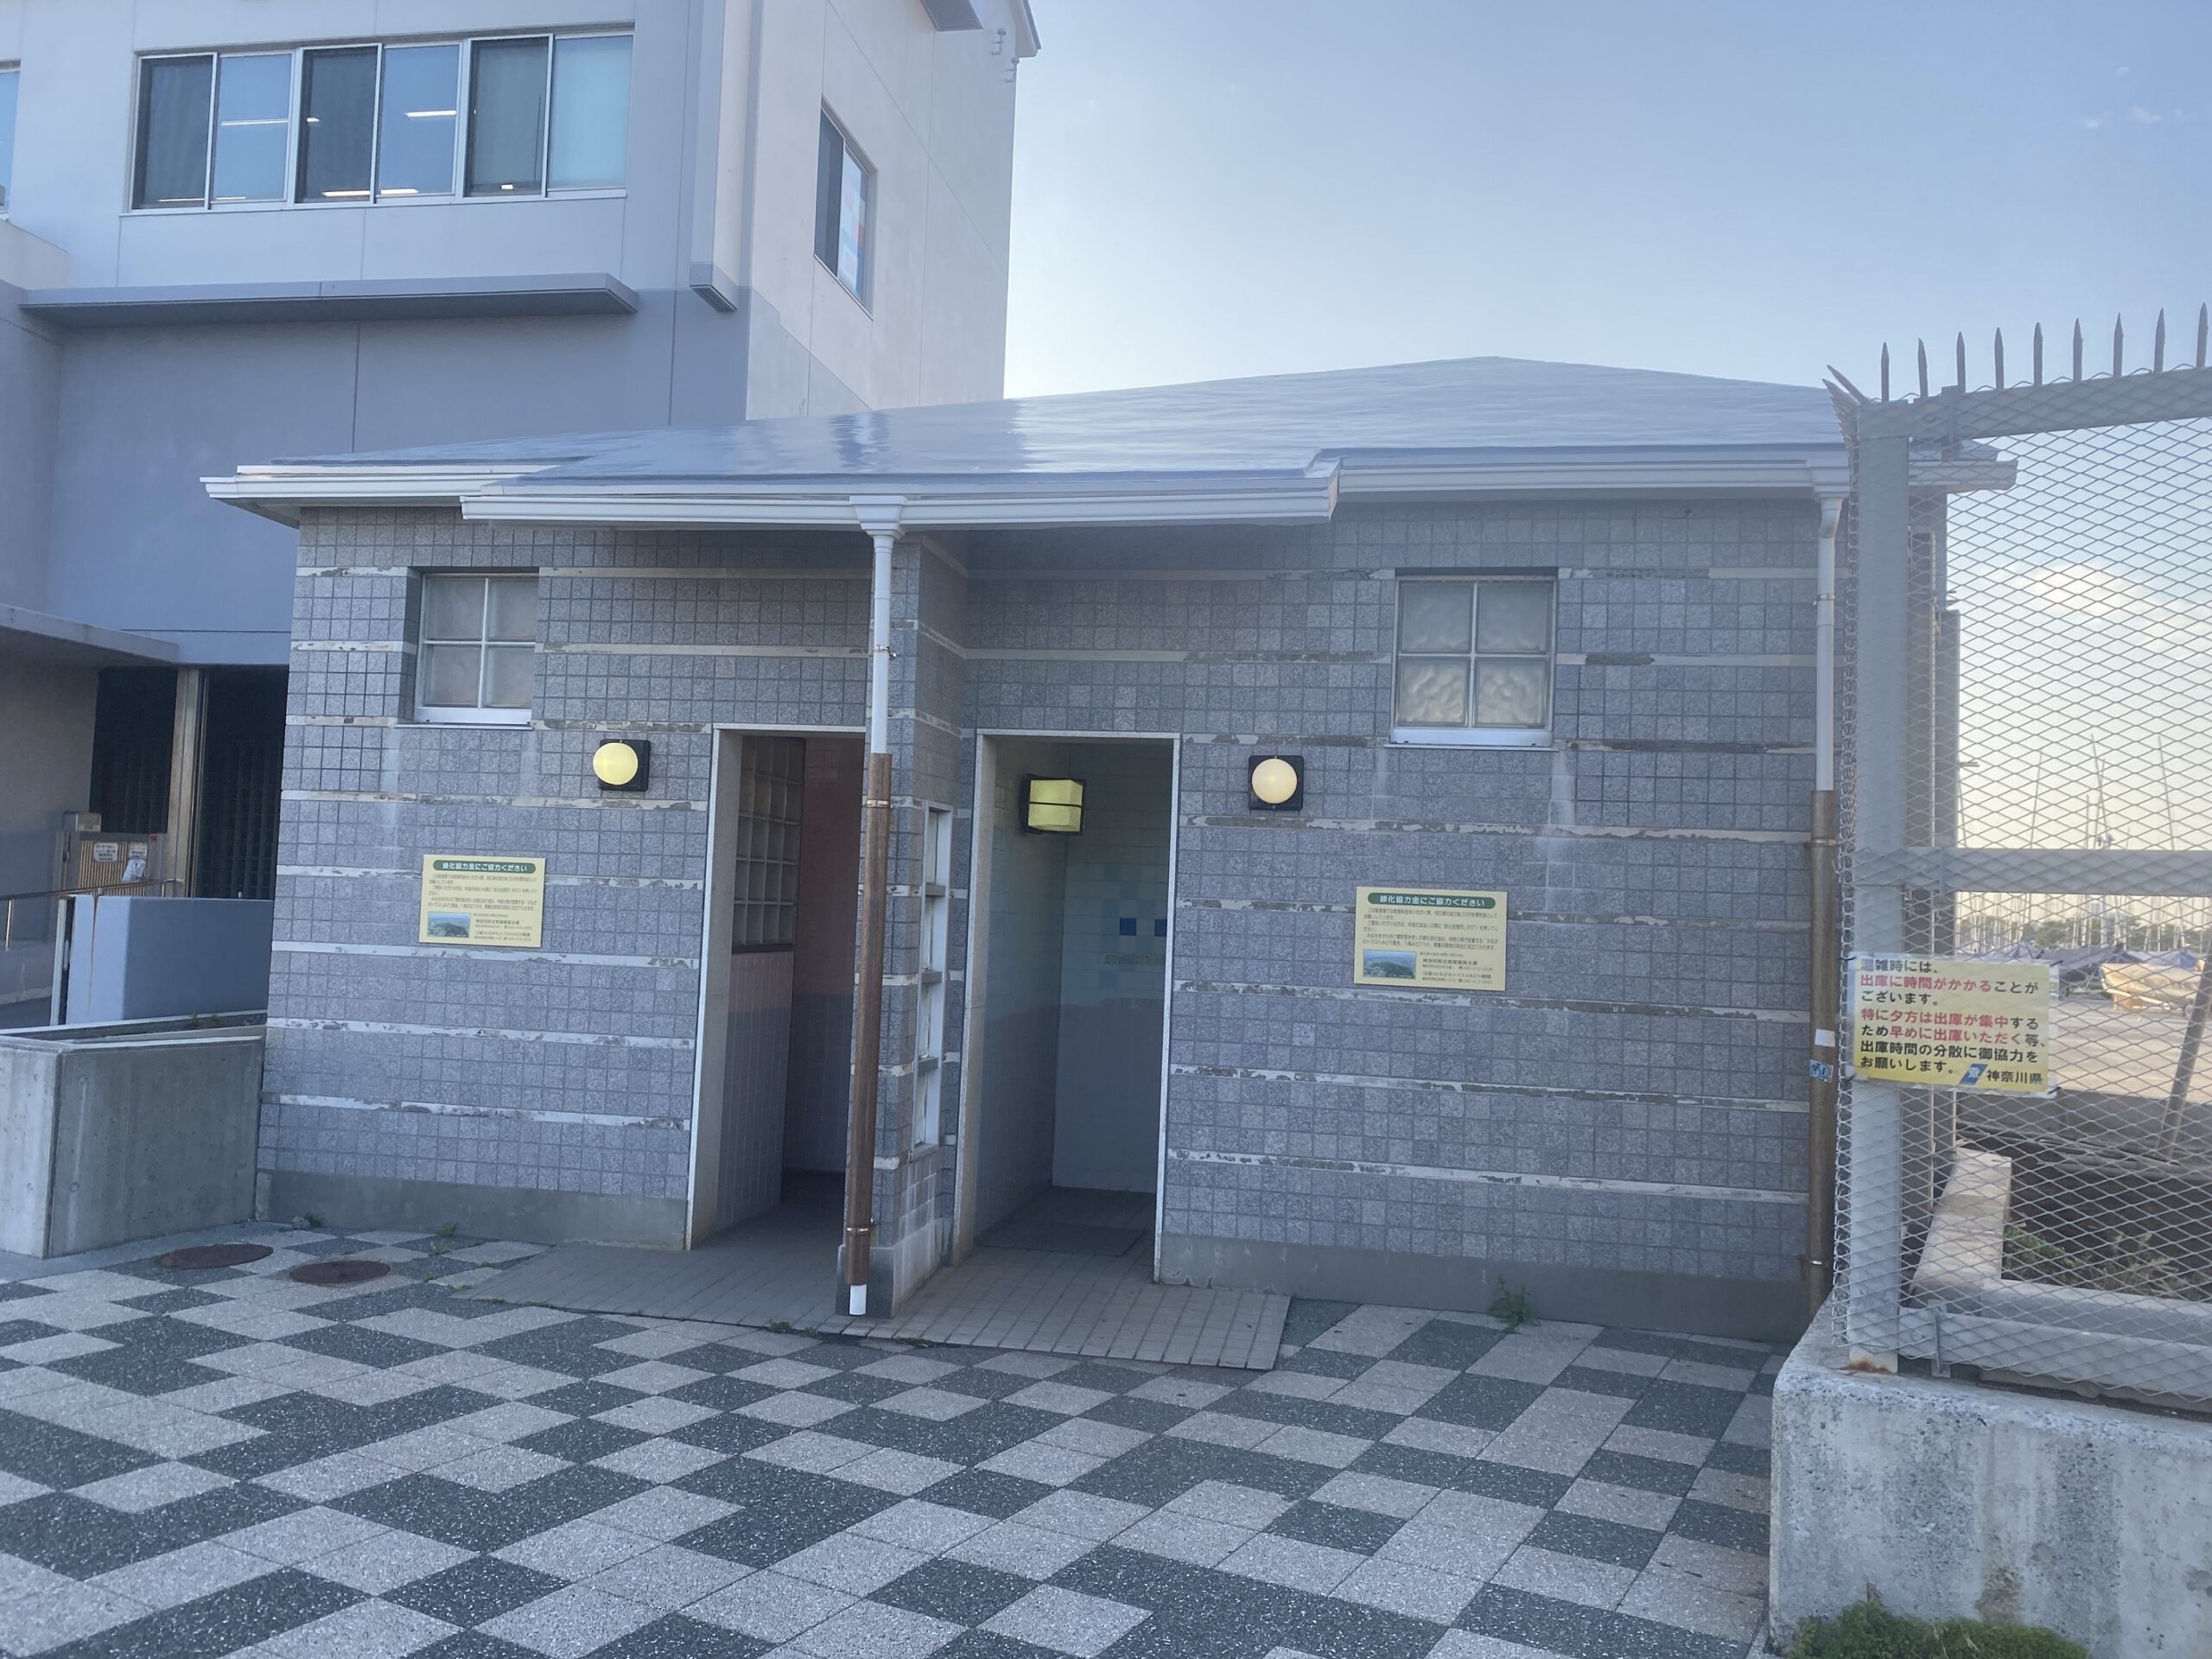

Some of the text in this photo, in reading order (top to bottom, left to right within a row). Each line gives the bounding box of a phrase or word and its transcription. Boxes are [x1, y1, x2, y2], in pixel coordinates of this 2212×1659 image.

[1380, 895, 1484, 906] 緑化協力金にご協力ください
[1860, 974, 2038, 995] 出庫に時間がかかることが
[1861, 990, 1939, 1006] ございます。
[1861, 1008, 2039, 1030] 特に夕方は出庫が集中する
[1861, 1025, 2045, 1048] ため早めに出庫いただく等、
[1860, 1040, 2038, 1063] 出庫時間の分散に御協力を
[1860, 1056, 1955, 1074] お願いします。
[1986, 1069, 2044, 1084] 神奈川県
